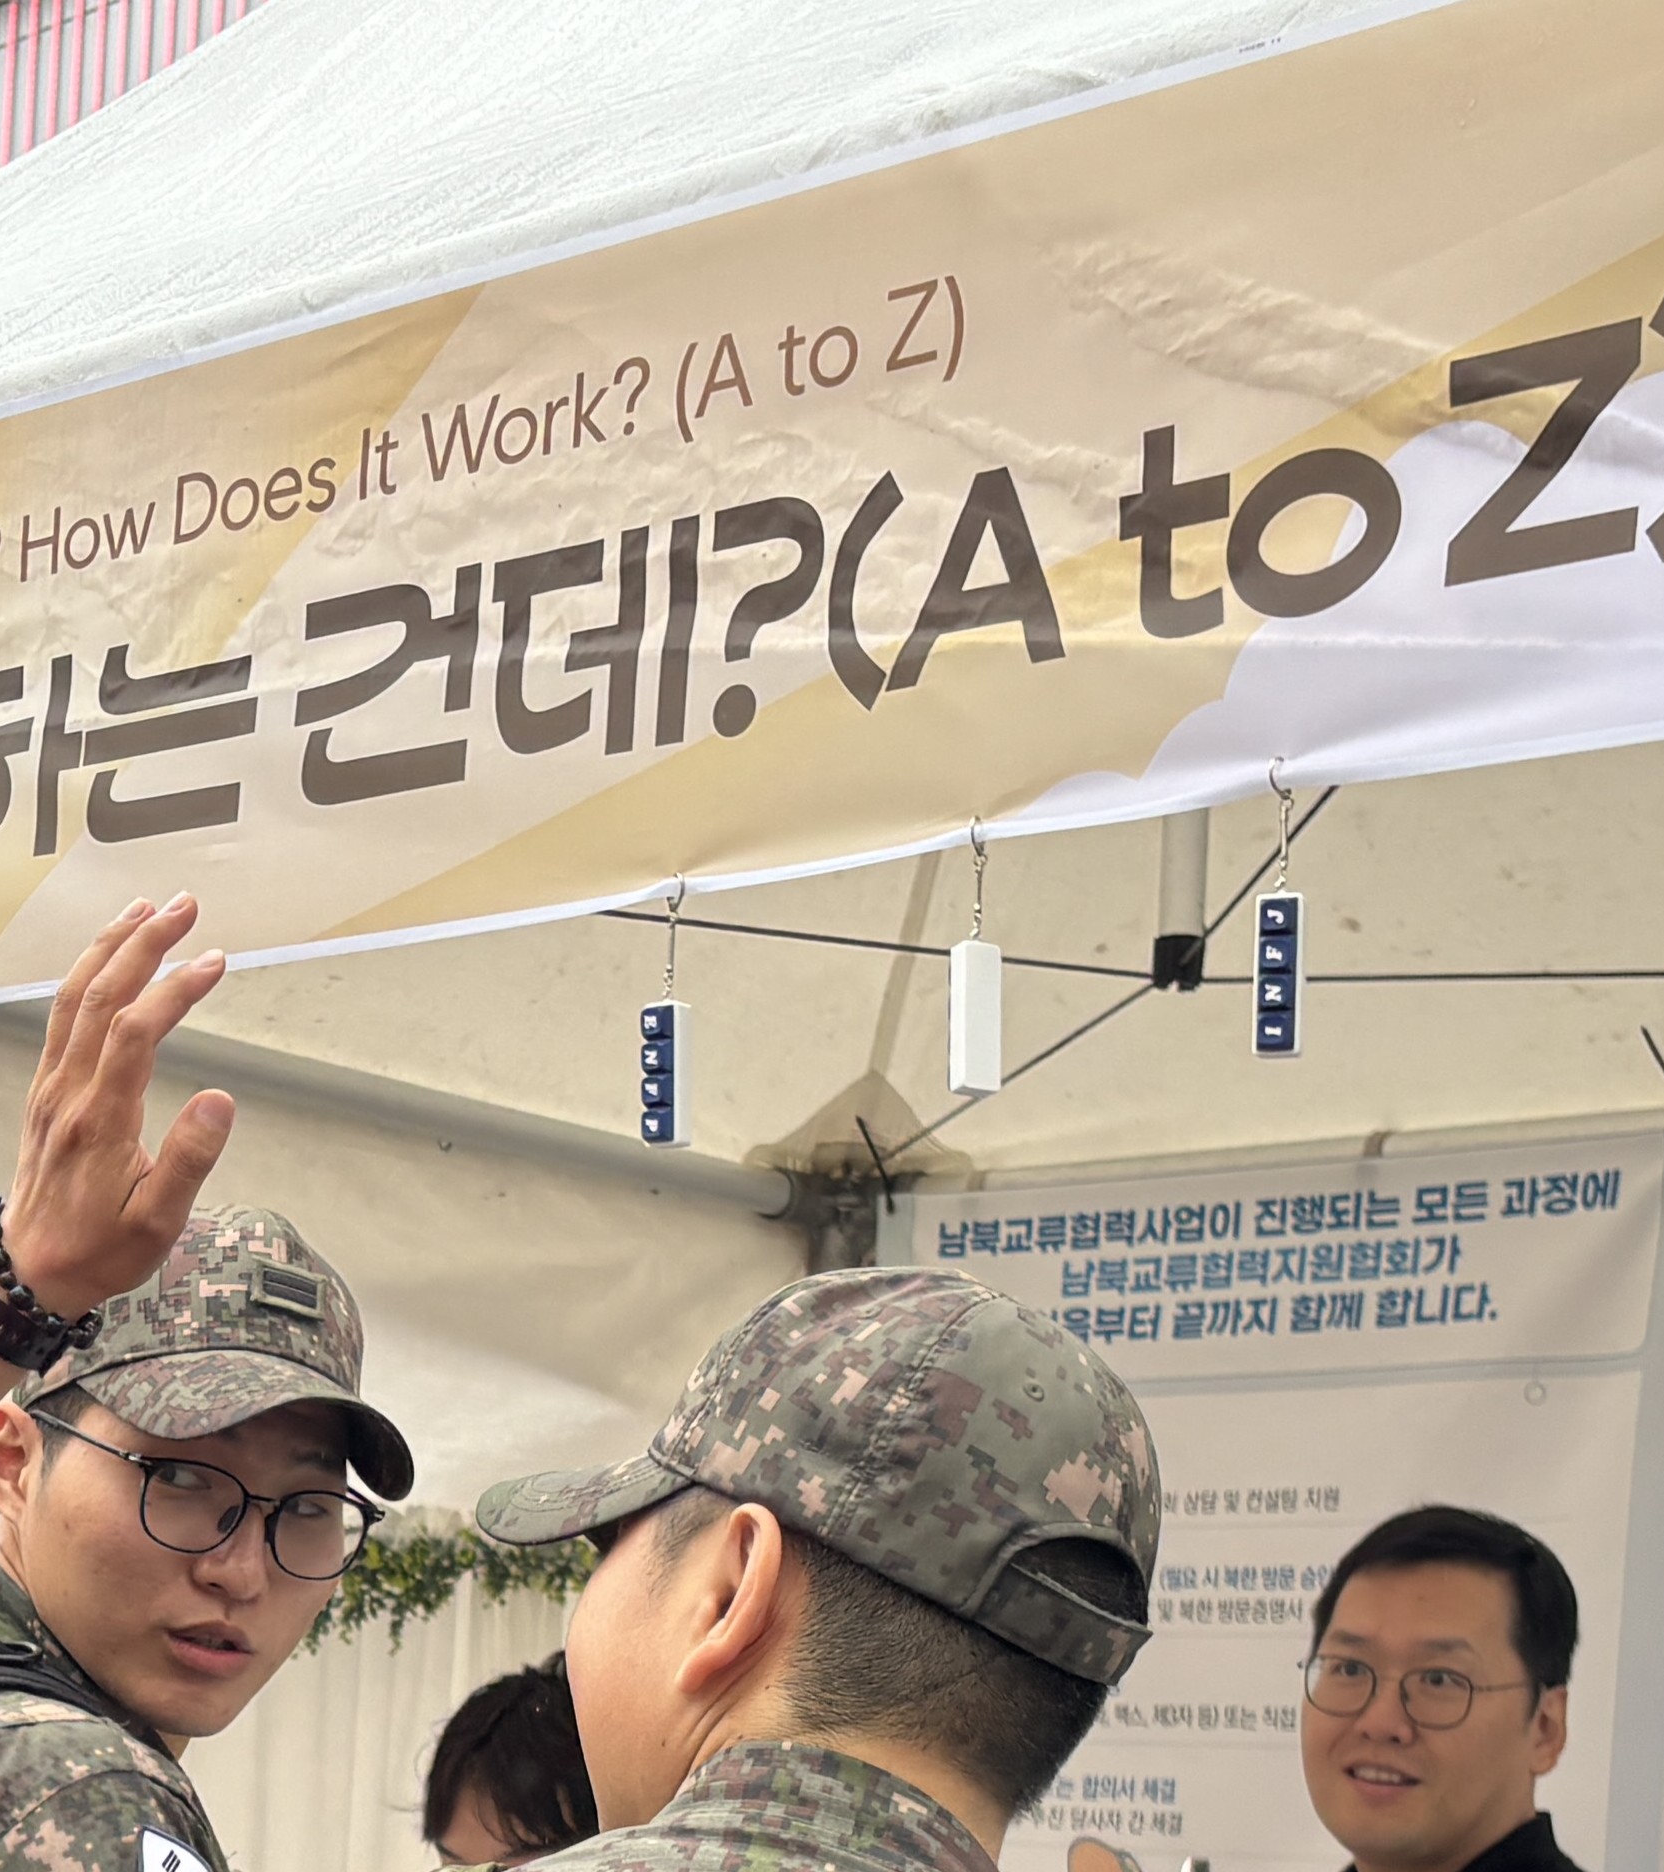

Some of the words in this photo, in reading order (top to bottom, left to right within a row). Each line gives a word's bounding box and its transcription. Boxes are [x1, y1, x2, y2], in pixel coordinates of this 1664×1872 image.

[18, 501, 155, 584] How
[172, 454, 338, 546] Does
[357, 427, 400, 502] It
[421, 355, 652, 482] Work?
[675, 332, 754, 443] (A
[777, 324, 861, 396] to
[885, 275, 967, 382] Z)
[1118, 423, 1403, 640] to
[937, 1200, 1242, 1259] 남북교류협력사업이
[1254, 1189, 1401, 1238] 진행되는
[1411, 1180, 1489, 1226] 모든
[1501, 1168, 1621, 1218] 과정에
[1061, 1234, 1462, 1299] 남북교류협력지원협회가
[1050, 1303, 1163, 1345] 음부터
[1172, 1297, 1278, 1340] 끝까지
[1289, 1290, 1364, 1334] 함께
[1375, 1281, 1498, 1329] 합니다.
